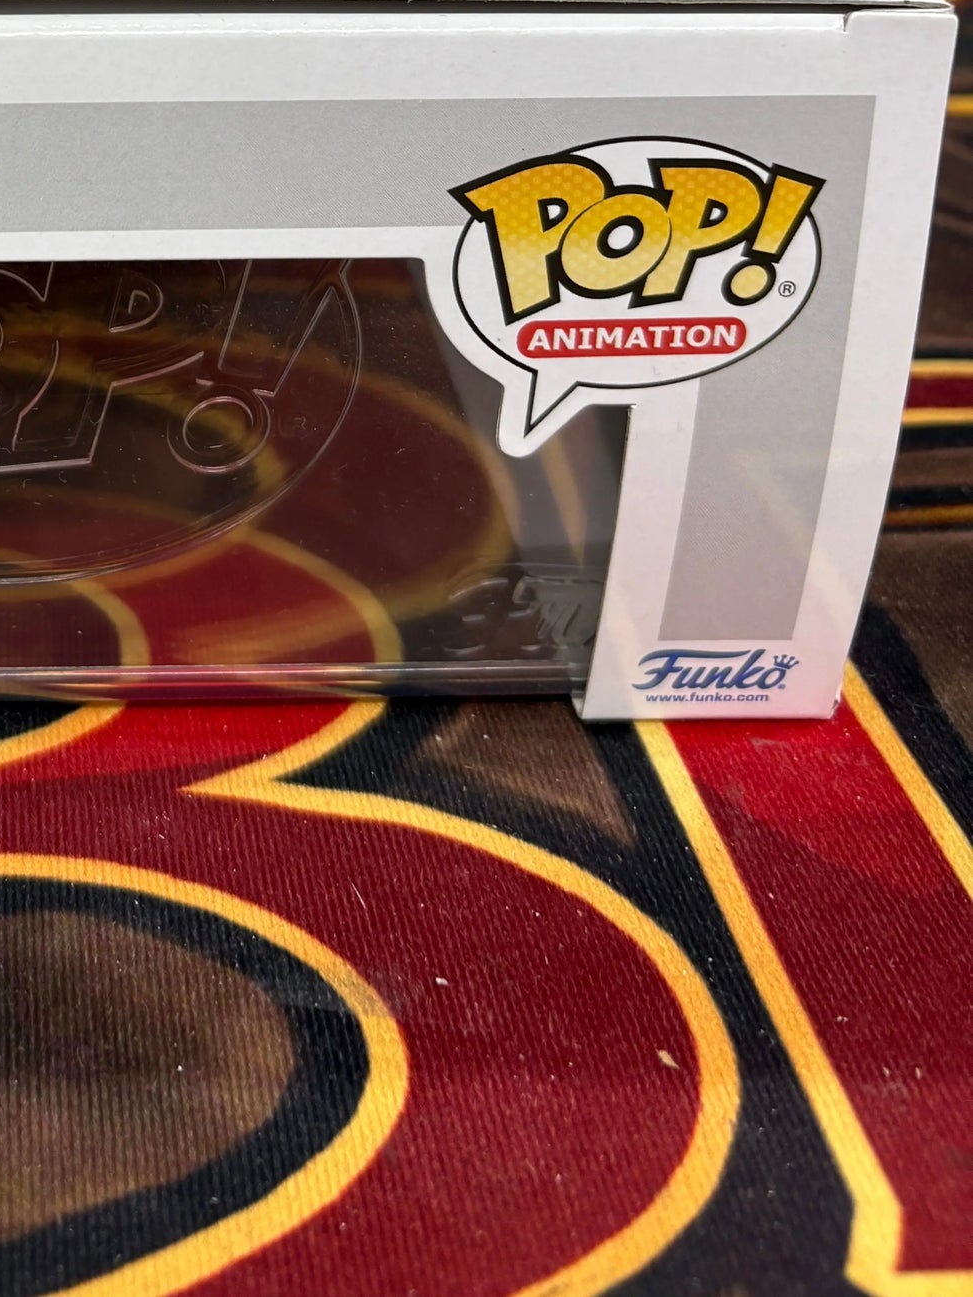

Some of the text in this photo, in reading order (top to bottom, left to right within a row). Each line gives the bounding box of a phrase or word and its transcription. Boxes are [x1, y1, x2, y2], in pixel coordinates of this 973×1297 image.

[448, 154, 827, 324] POP!
[526, 324, 738, 352] ANIMATION
[631, 648, 799, 690] Funko
[645, 691, 770, 703] www.funko.com
